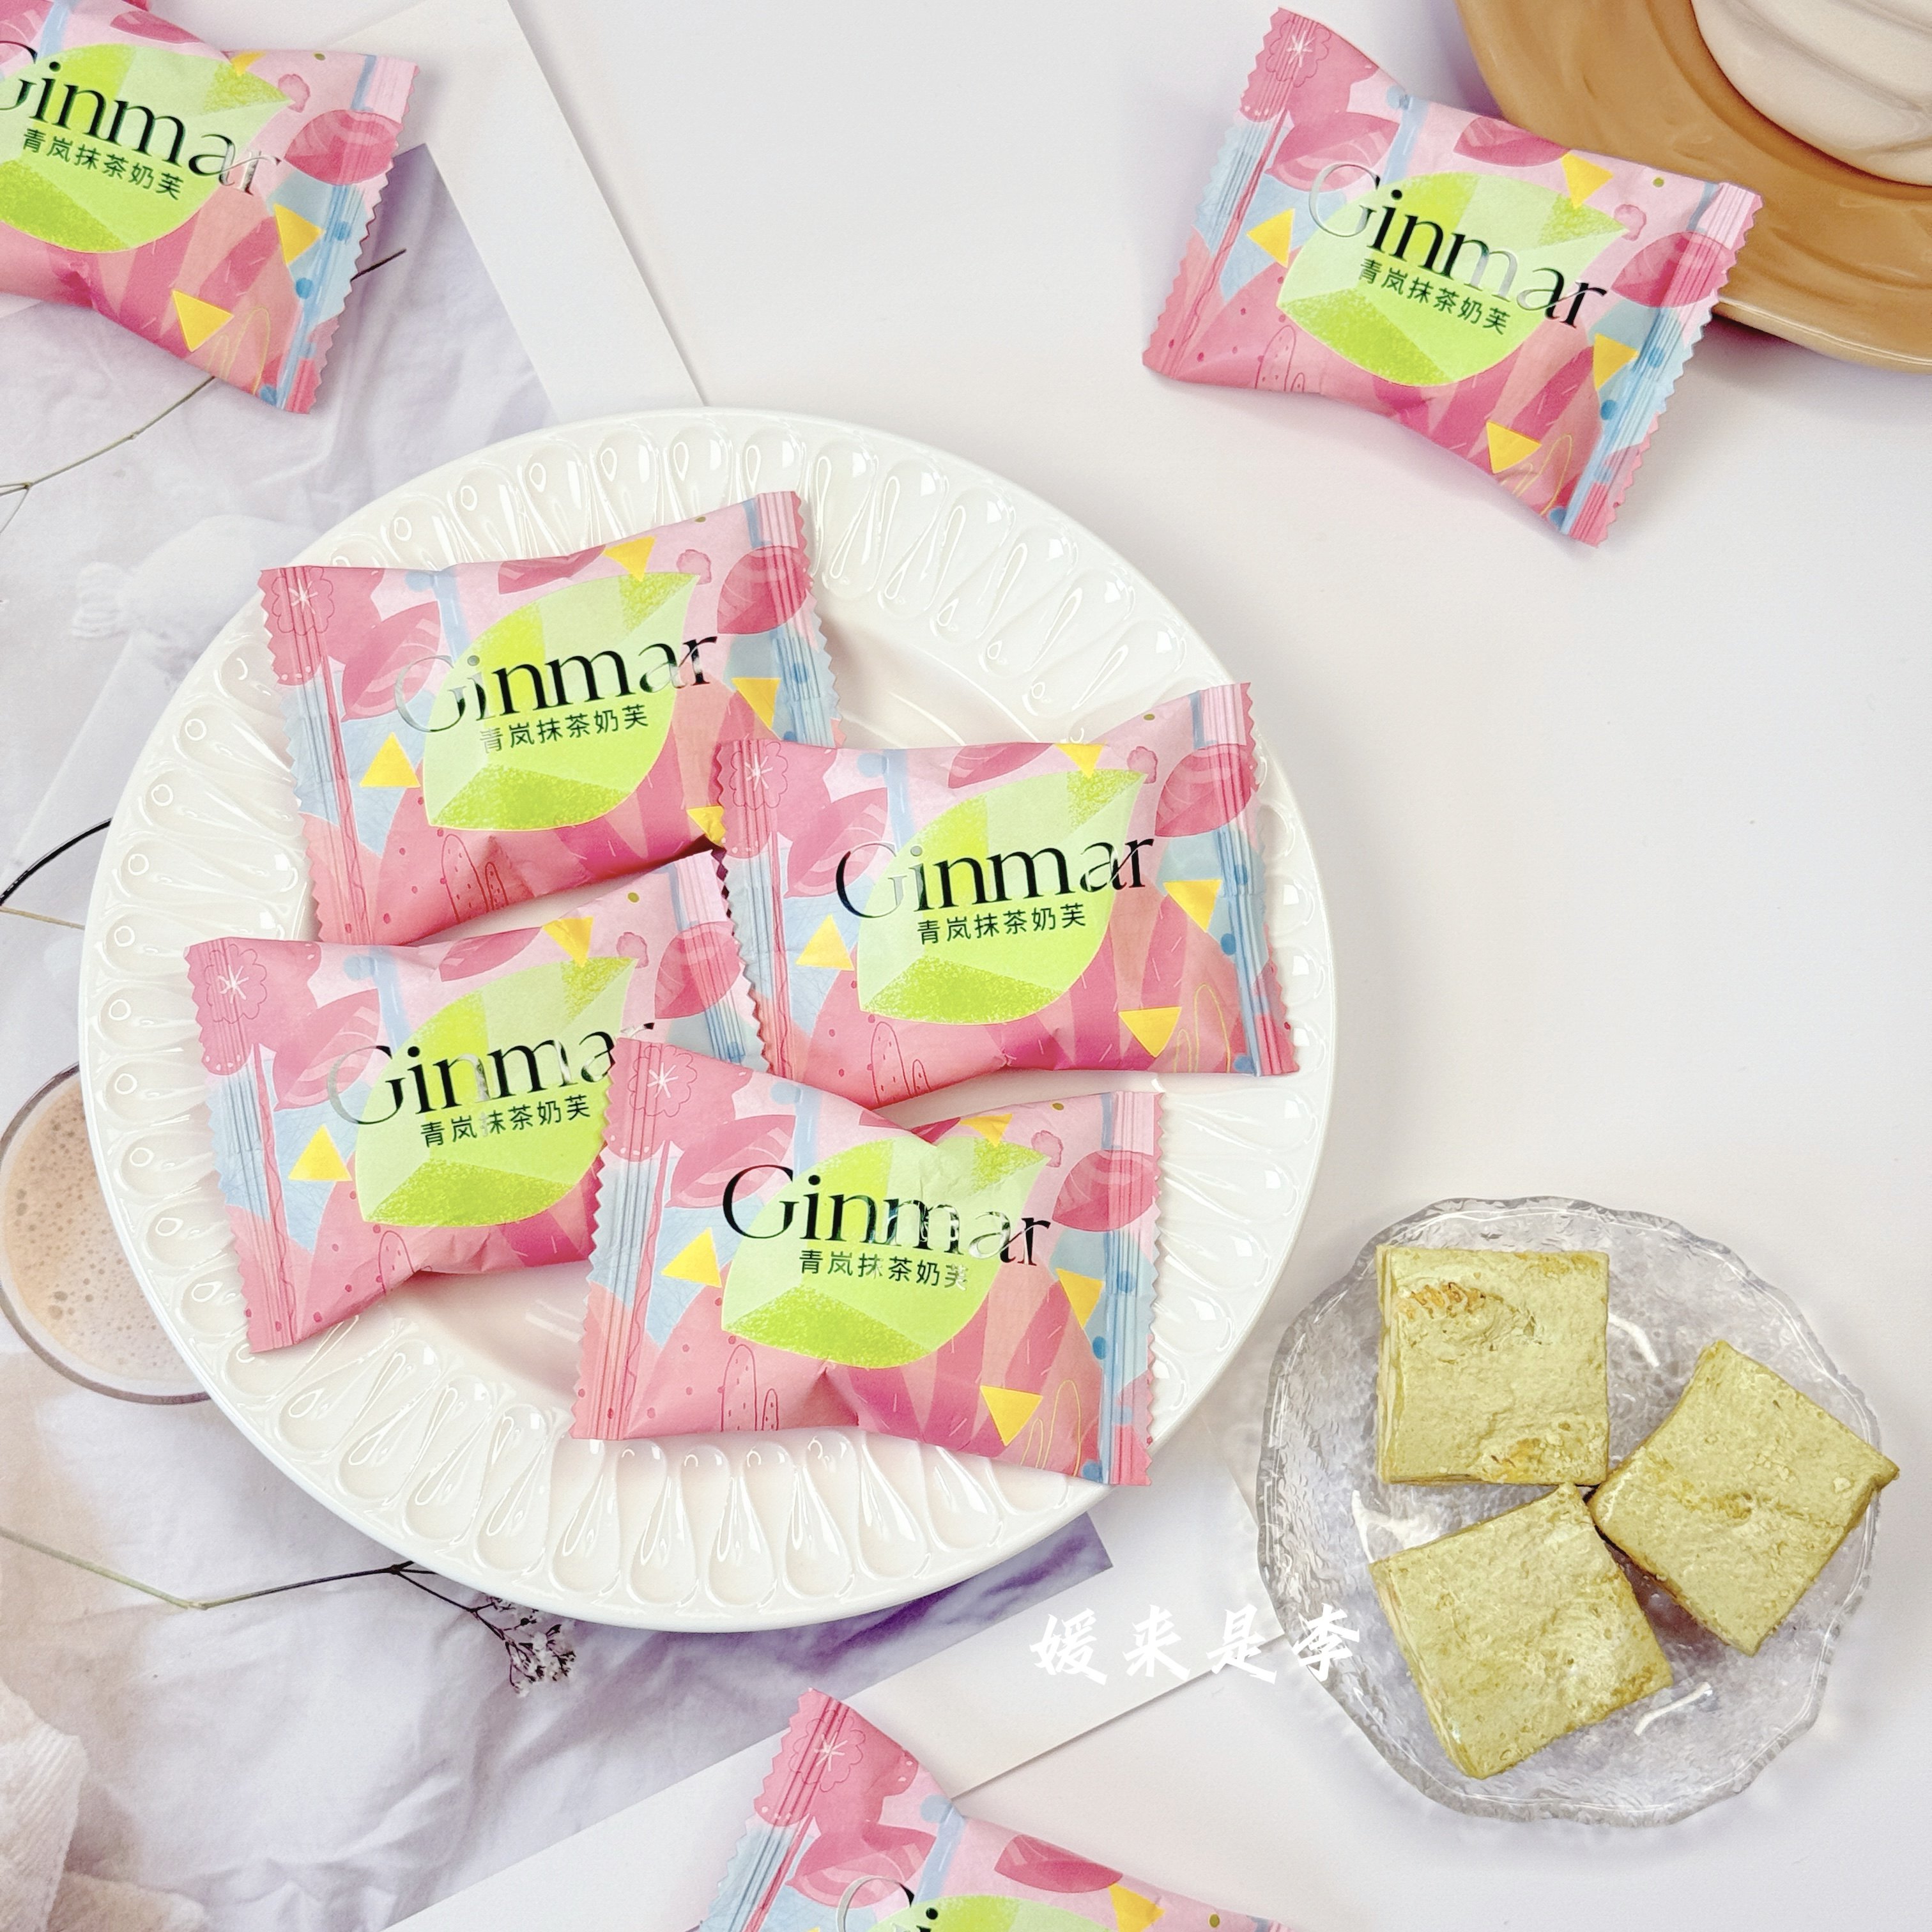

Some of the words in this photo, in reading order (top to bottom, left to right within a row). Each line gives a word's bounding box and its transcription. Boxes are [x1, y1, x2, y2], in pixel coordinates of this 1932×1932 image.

[23, 128, 184, 200] 青岚抹茶奶芙
[1308, 163, 1607, 328] Ginmar
[1358, 258, 1511, 335] 青岚抹茶奶芙
[394, 636, 717, 733] Ginmar
[479, 704, 648, 753] 青岚抹茶奶芙
[836, 838, 1154, 918] Ginmar
[917, 902, 1086, 945] 青岚抹茶奶芙
[328, 1022, 654, 1125] Ginma
[420, 1094, 590, 1147] 青岚抹茶奶芙
[723, 1164, 1050, 1266] Ginmar
[799, 1250, 967, 1291] 青岚抹茶奶芙
